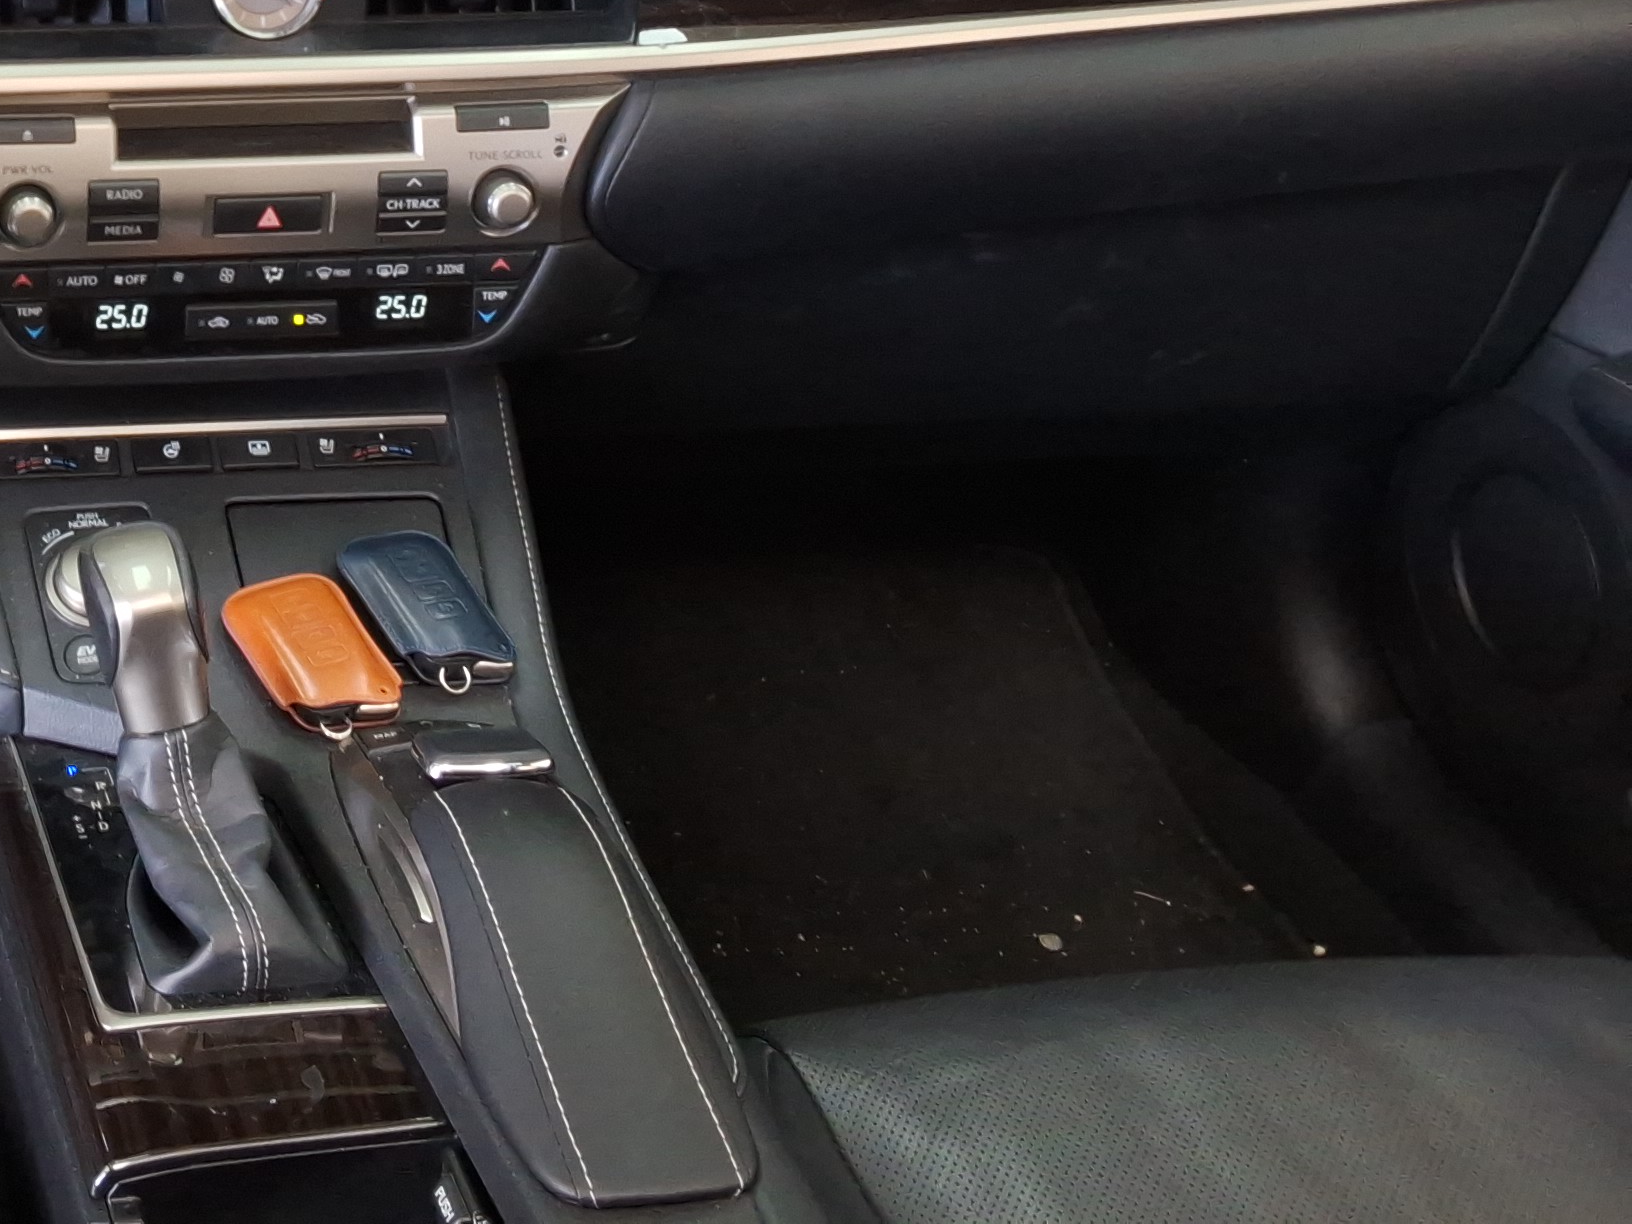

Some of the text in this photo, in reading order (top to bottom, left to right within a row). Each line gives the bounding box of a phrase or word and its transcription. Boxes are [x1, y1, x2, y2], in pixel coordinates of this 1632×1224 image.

[106, 189, 143, 200] RADIO
[104, 226, 142, 235] MEDIA
[66, 276, 98, 287] AUTO
[125, 274, 147, 285] OFF
[482, 291, 508, 301] TEMP
[17, 307, 43, 317] TEMP
[376, 295, 427, 319] 25.0
[95, 303, 148, 329] 25.0
[256, 316, 279, 325] AUTO
[77, 644, 96, 656] EV
[434, 1185, 455, 1223] PUSH
